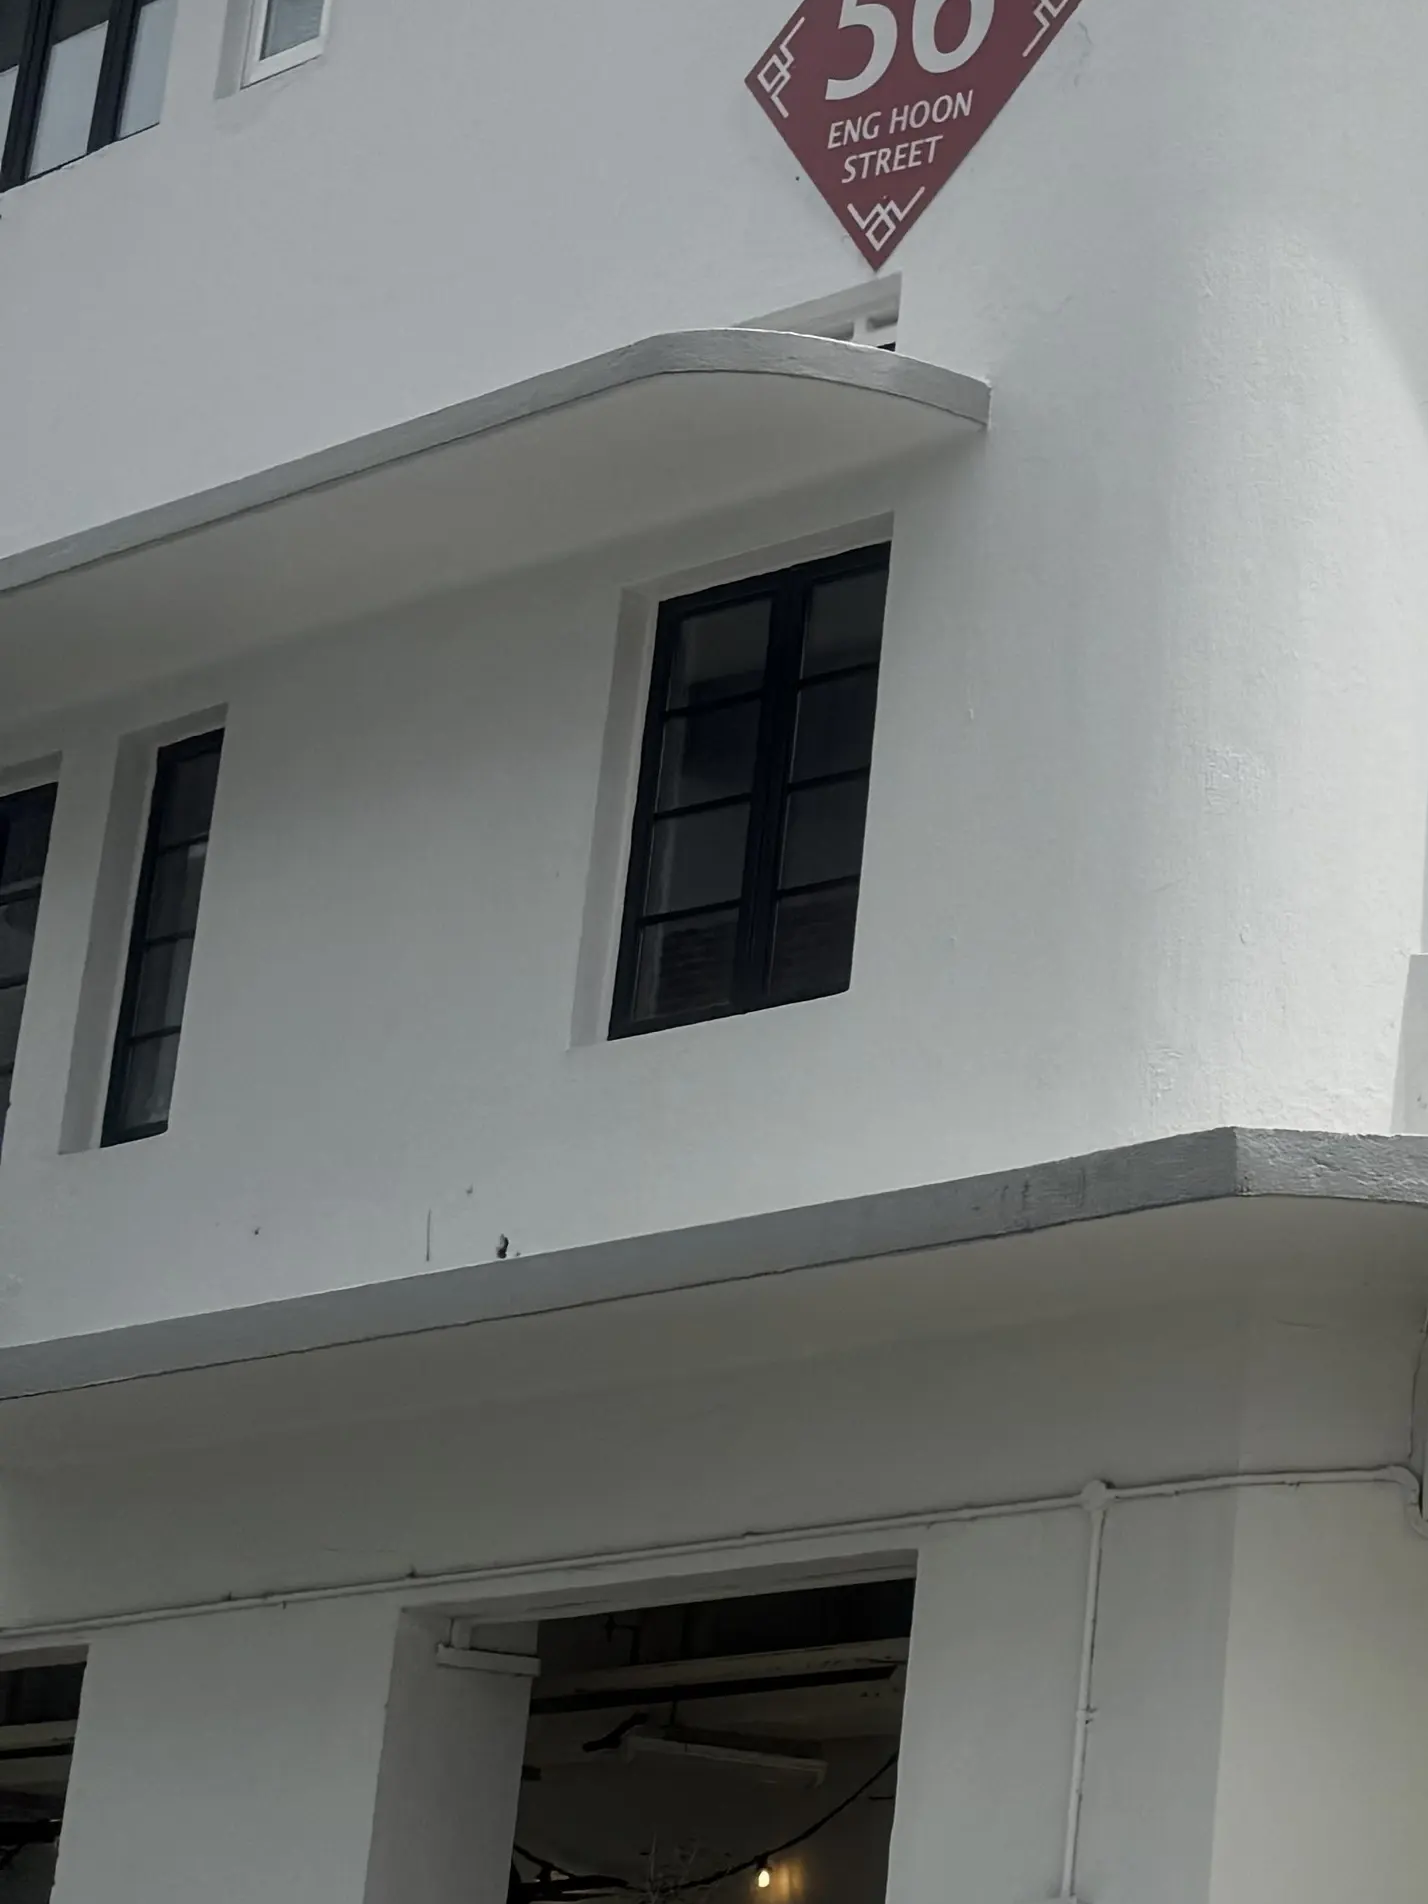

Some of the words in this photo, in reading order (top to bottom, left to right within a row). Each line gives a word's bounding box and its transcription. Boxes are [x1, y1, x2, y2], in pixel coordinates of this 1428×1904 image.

[827, 110, 882, 150] ENG
[888, 89, 974, 134] HOON
[841, 134, 944, 184] STREET
